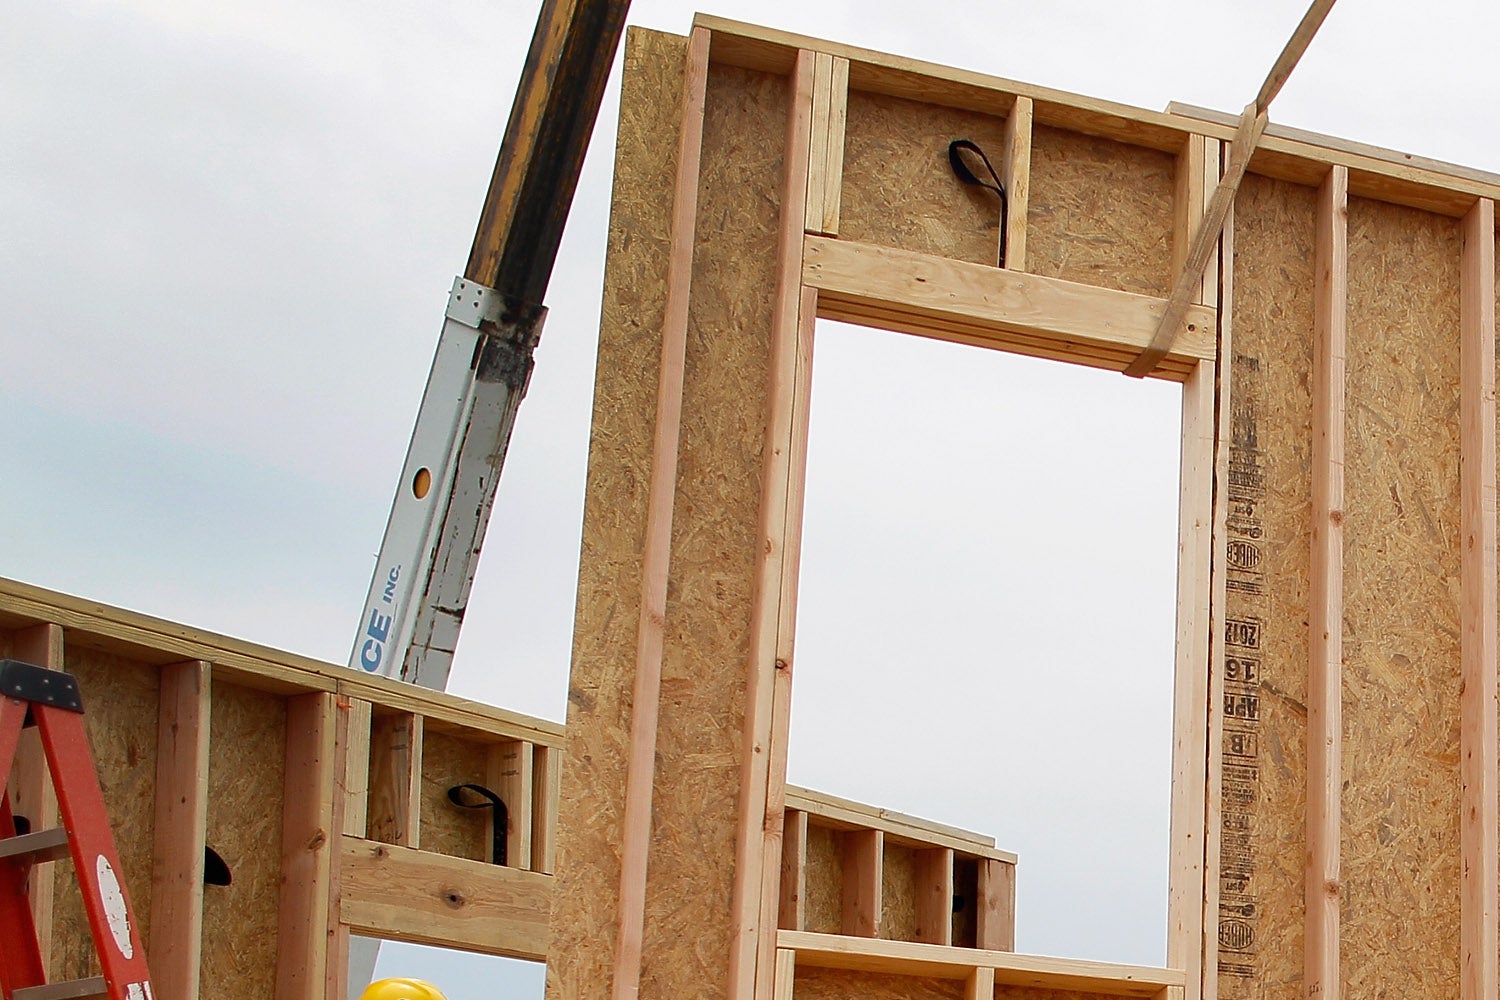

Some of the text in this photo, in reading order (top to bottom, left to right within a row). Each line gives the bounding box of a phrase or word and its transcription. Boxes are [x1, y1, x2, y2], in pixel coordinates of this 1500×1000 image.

[1227, 543, 1259, 569] HUBER
[360, 564, 402, 672] CE INC.
[1225, 659, 1256, 680] 16
[1224, 696, 1257, 718] APR
[1230, 734, 1244, 754] B
[1218, 922, 1252, 948] HUBER
